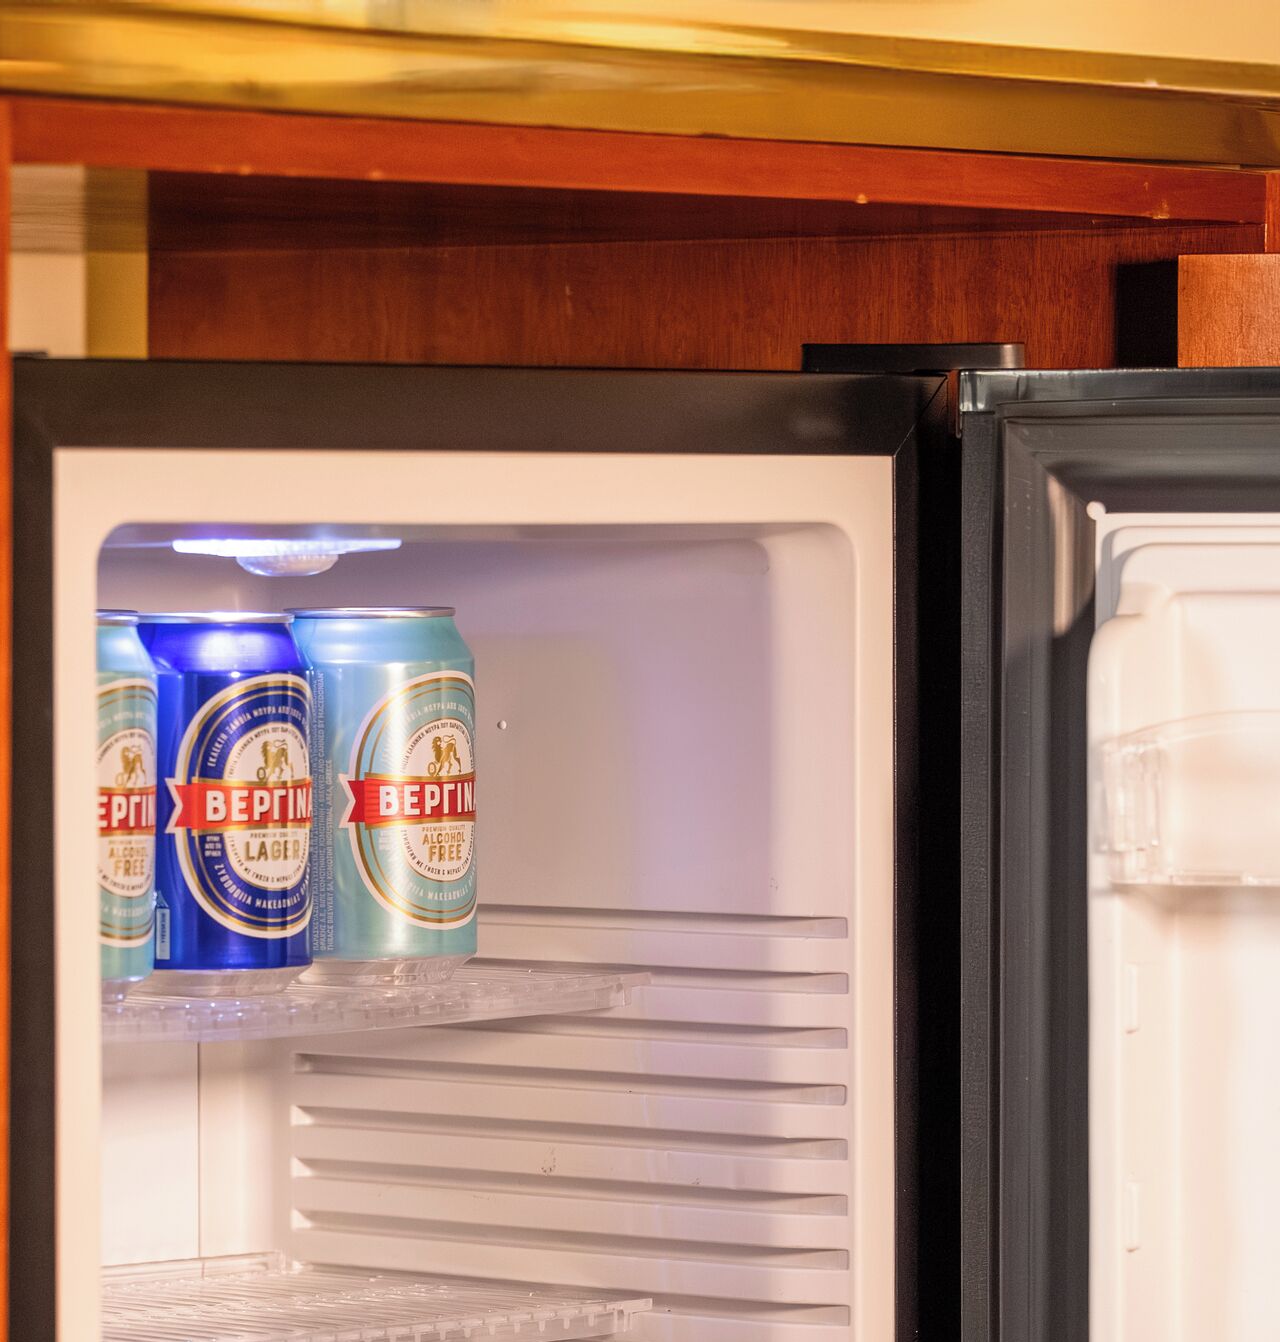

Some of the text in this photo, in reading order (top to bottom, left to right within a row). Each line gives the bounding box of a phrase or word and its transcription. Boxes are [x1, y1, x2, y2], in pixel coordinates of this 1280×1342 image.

[422, 831, 466, 846] ALCOHOL
[108, 846, 149, 859] ALCOHOL
[245, 839, 301, 862] LAGER
[428, 843, 463, 864] FREE
[113, 858, 145, 877] FREE
